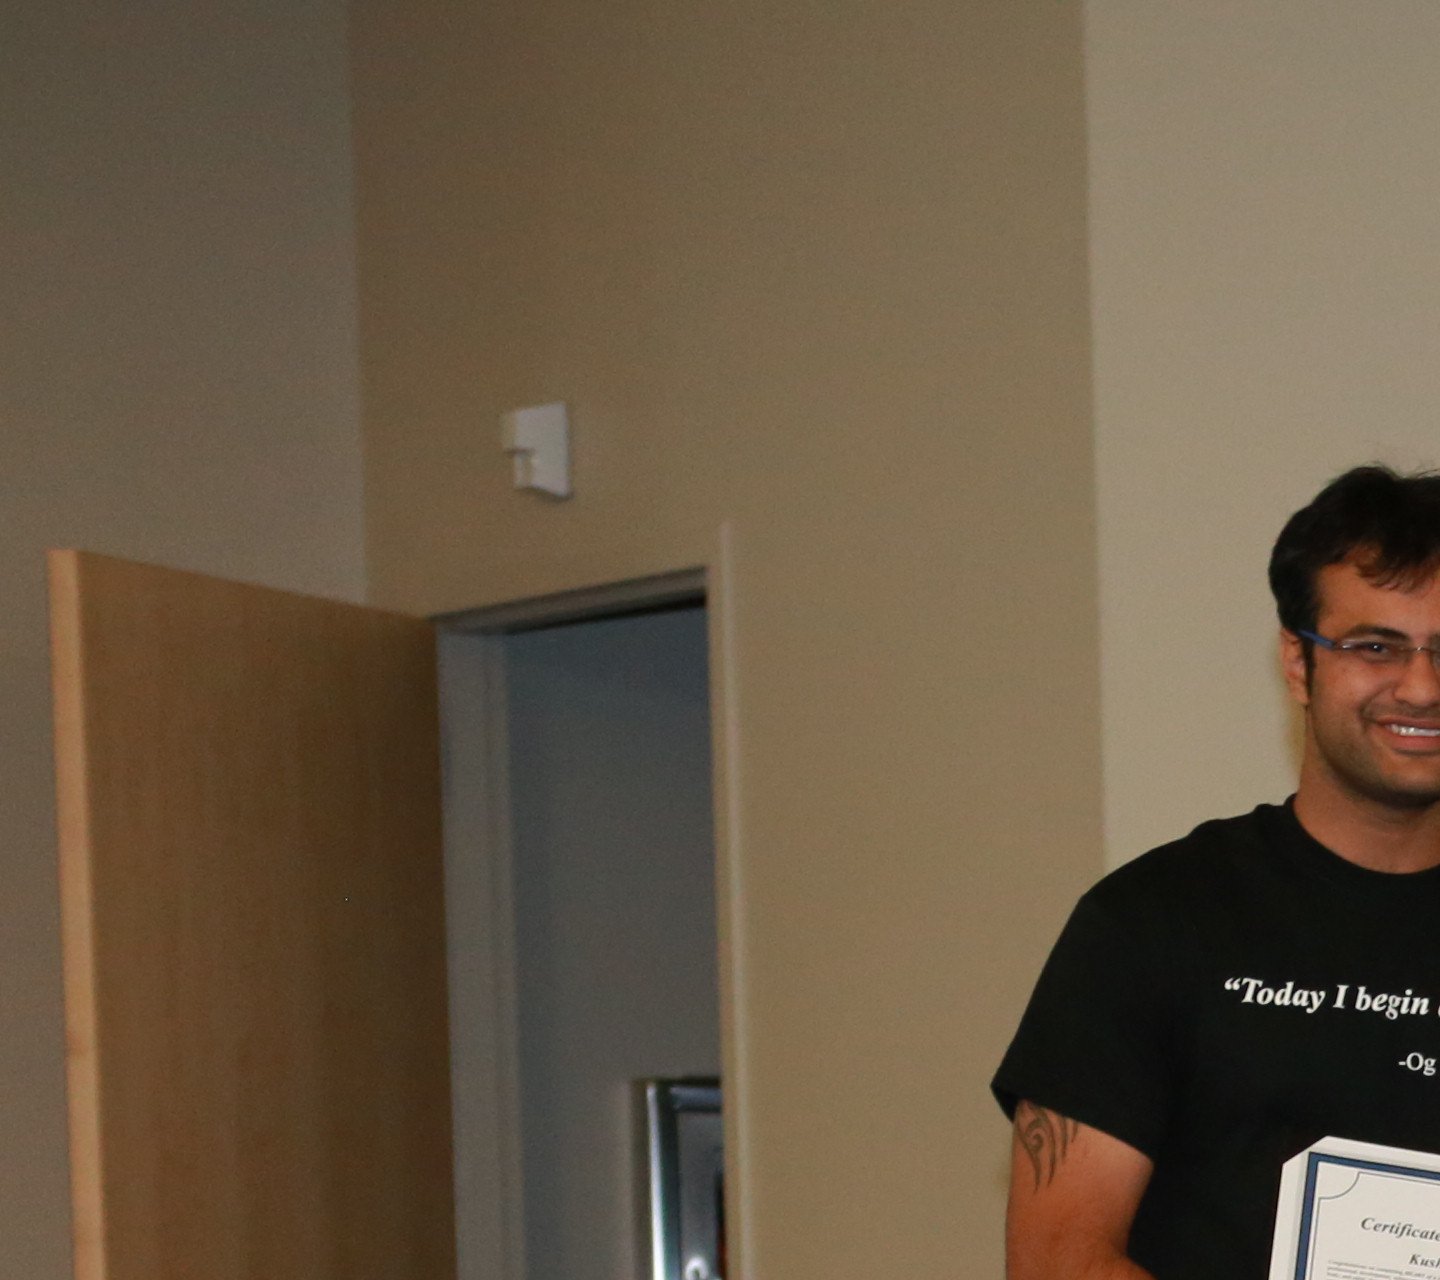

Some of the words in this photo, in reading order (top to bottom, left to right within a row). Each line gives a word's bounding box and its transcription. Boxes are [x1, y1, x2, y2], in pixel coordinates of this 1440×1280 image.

[1333, 985, 1348, 1008] I
[1355, 987, 1429, 1019] begin
[1399, 1053, 1436, 1076] -Og
